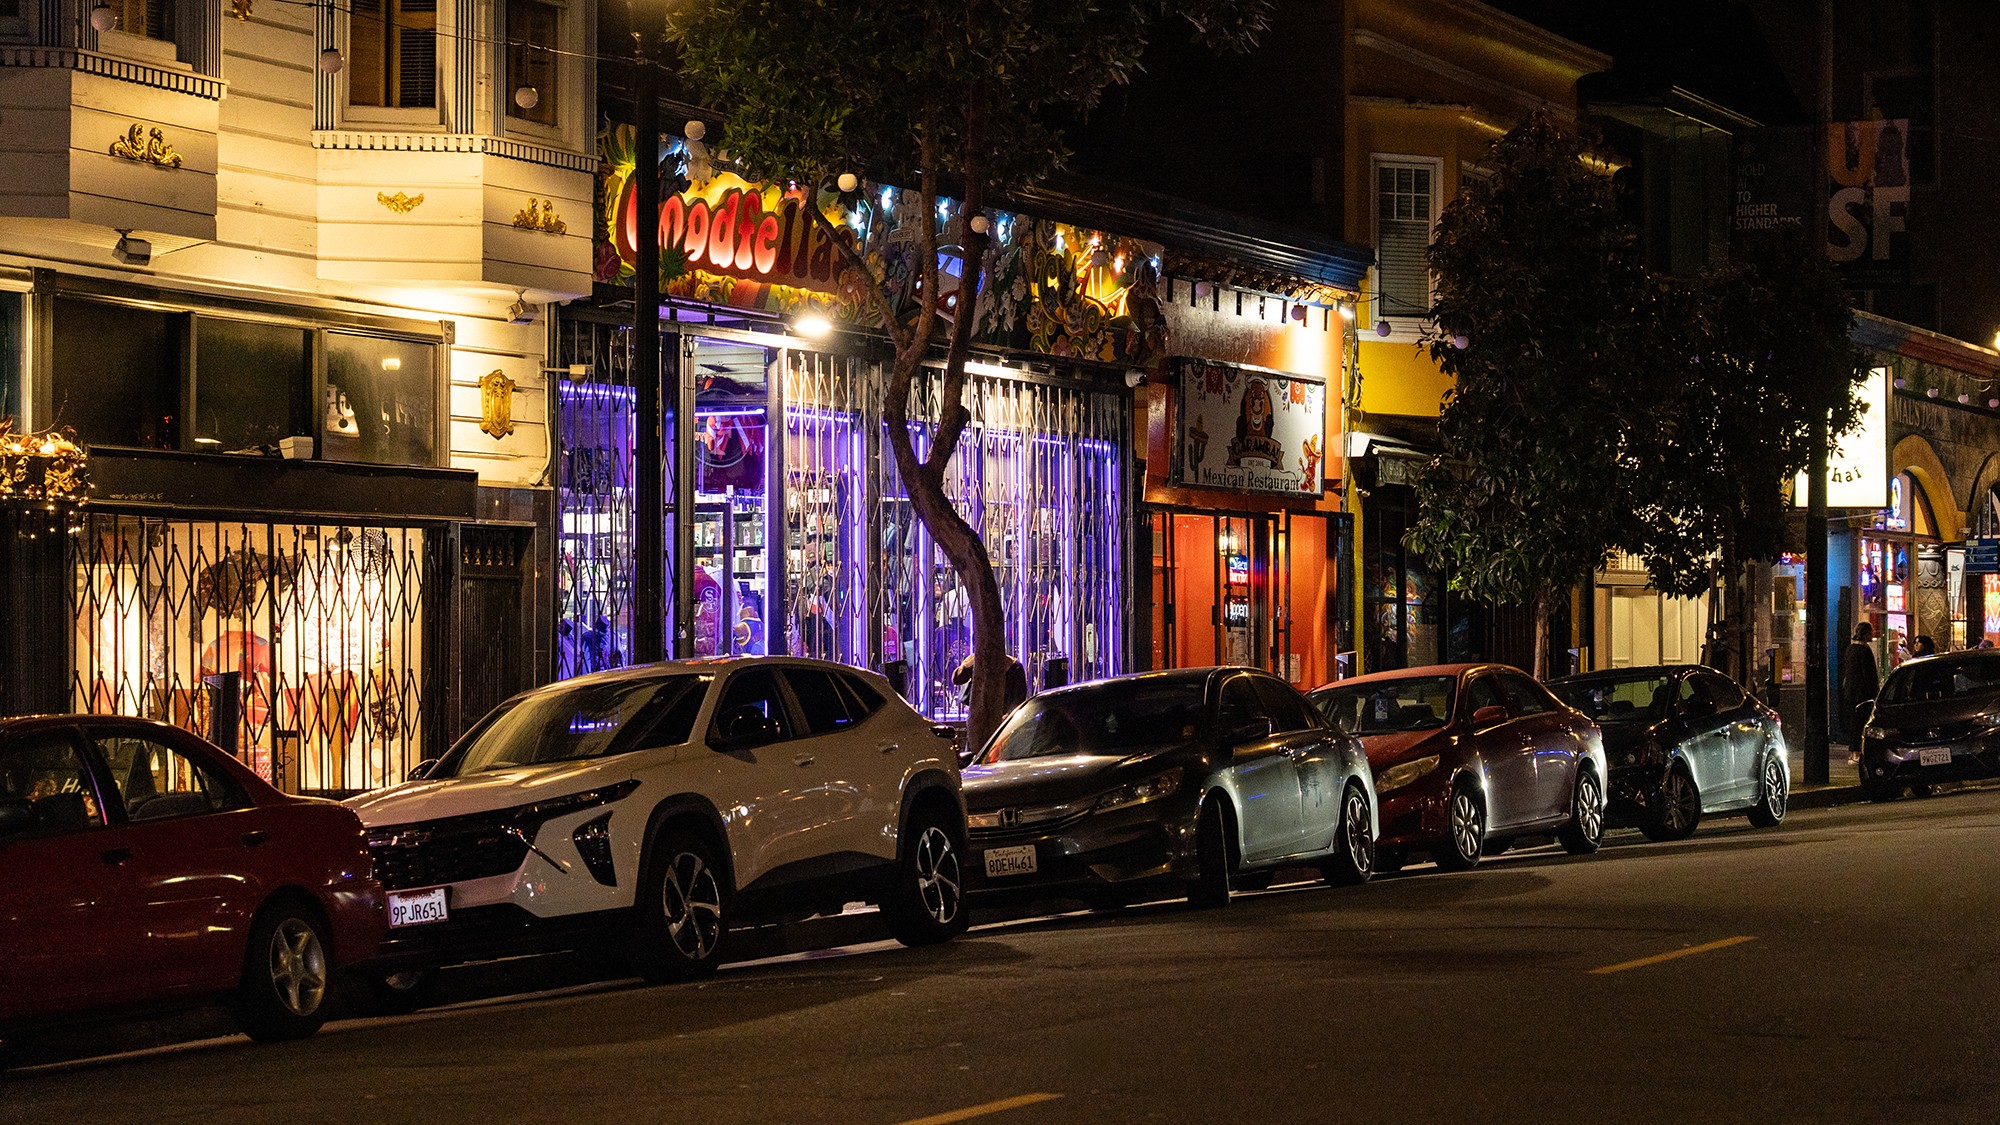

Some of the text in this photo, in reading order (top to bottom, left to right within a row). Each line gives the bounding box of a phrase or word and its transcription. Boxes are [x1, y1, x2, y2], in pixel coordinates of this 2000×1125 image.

[1737, 163, 1766, 176] HOLD
[1736, 191, 1752, 203] TO
[1735, 203, 1778, 217] HIGHER
[1203, 467, 1300, 491] Mexican Restaurant
[1829, 465, 1862, 483] hai
[988, 856, 1034, 873] 8DEH461
[393, 901, 445, 924] 9PJR651
